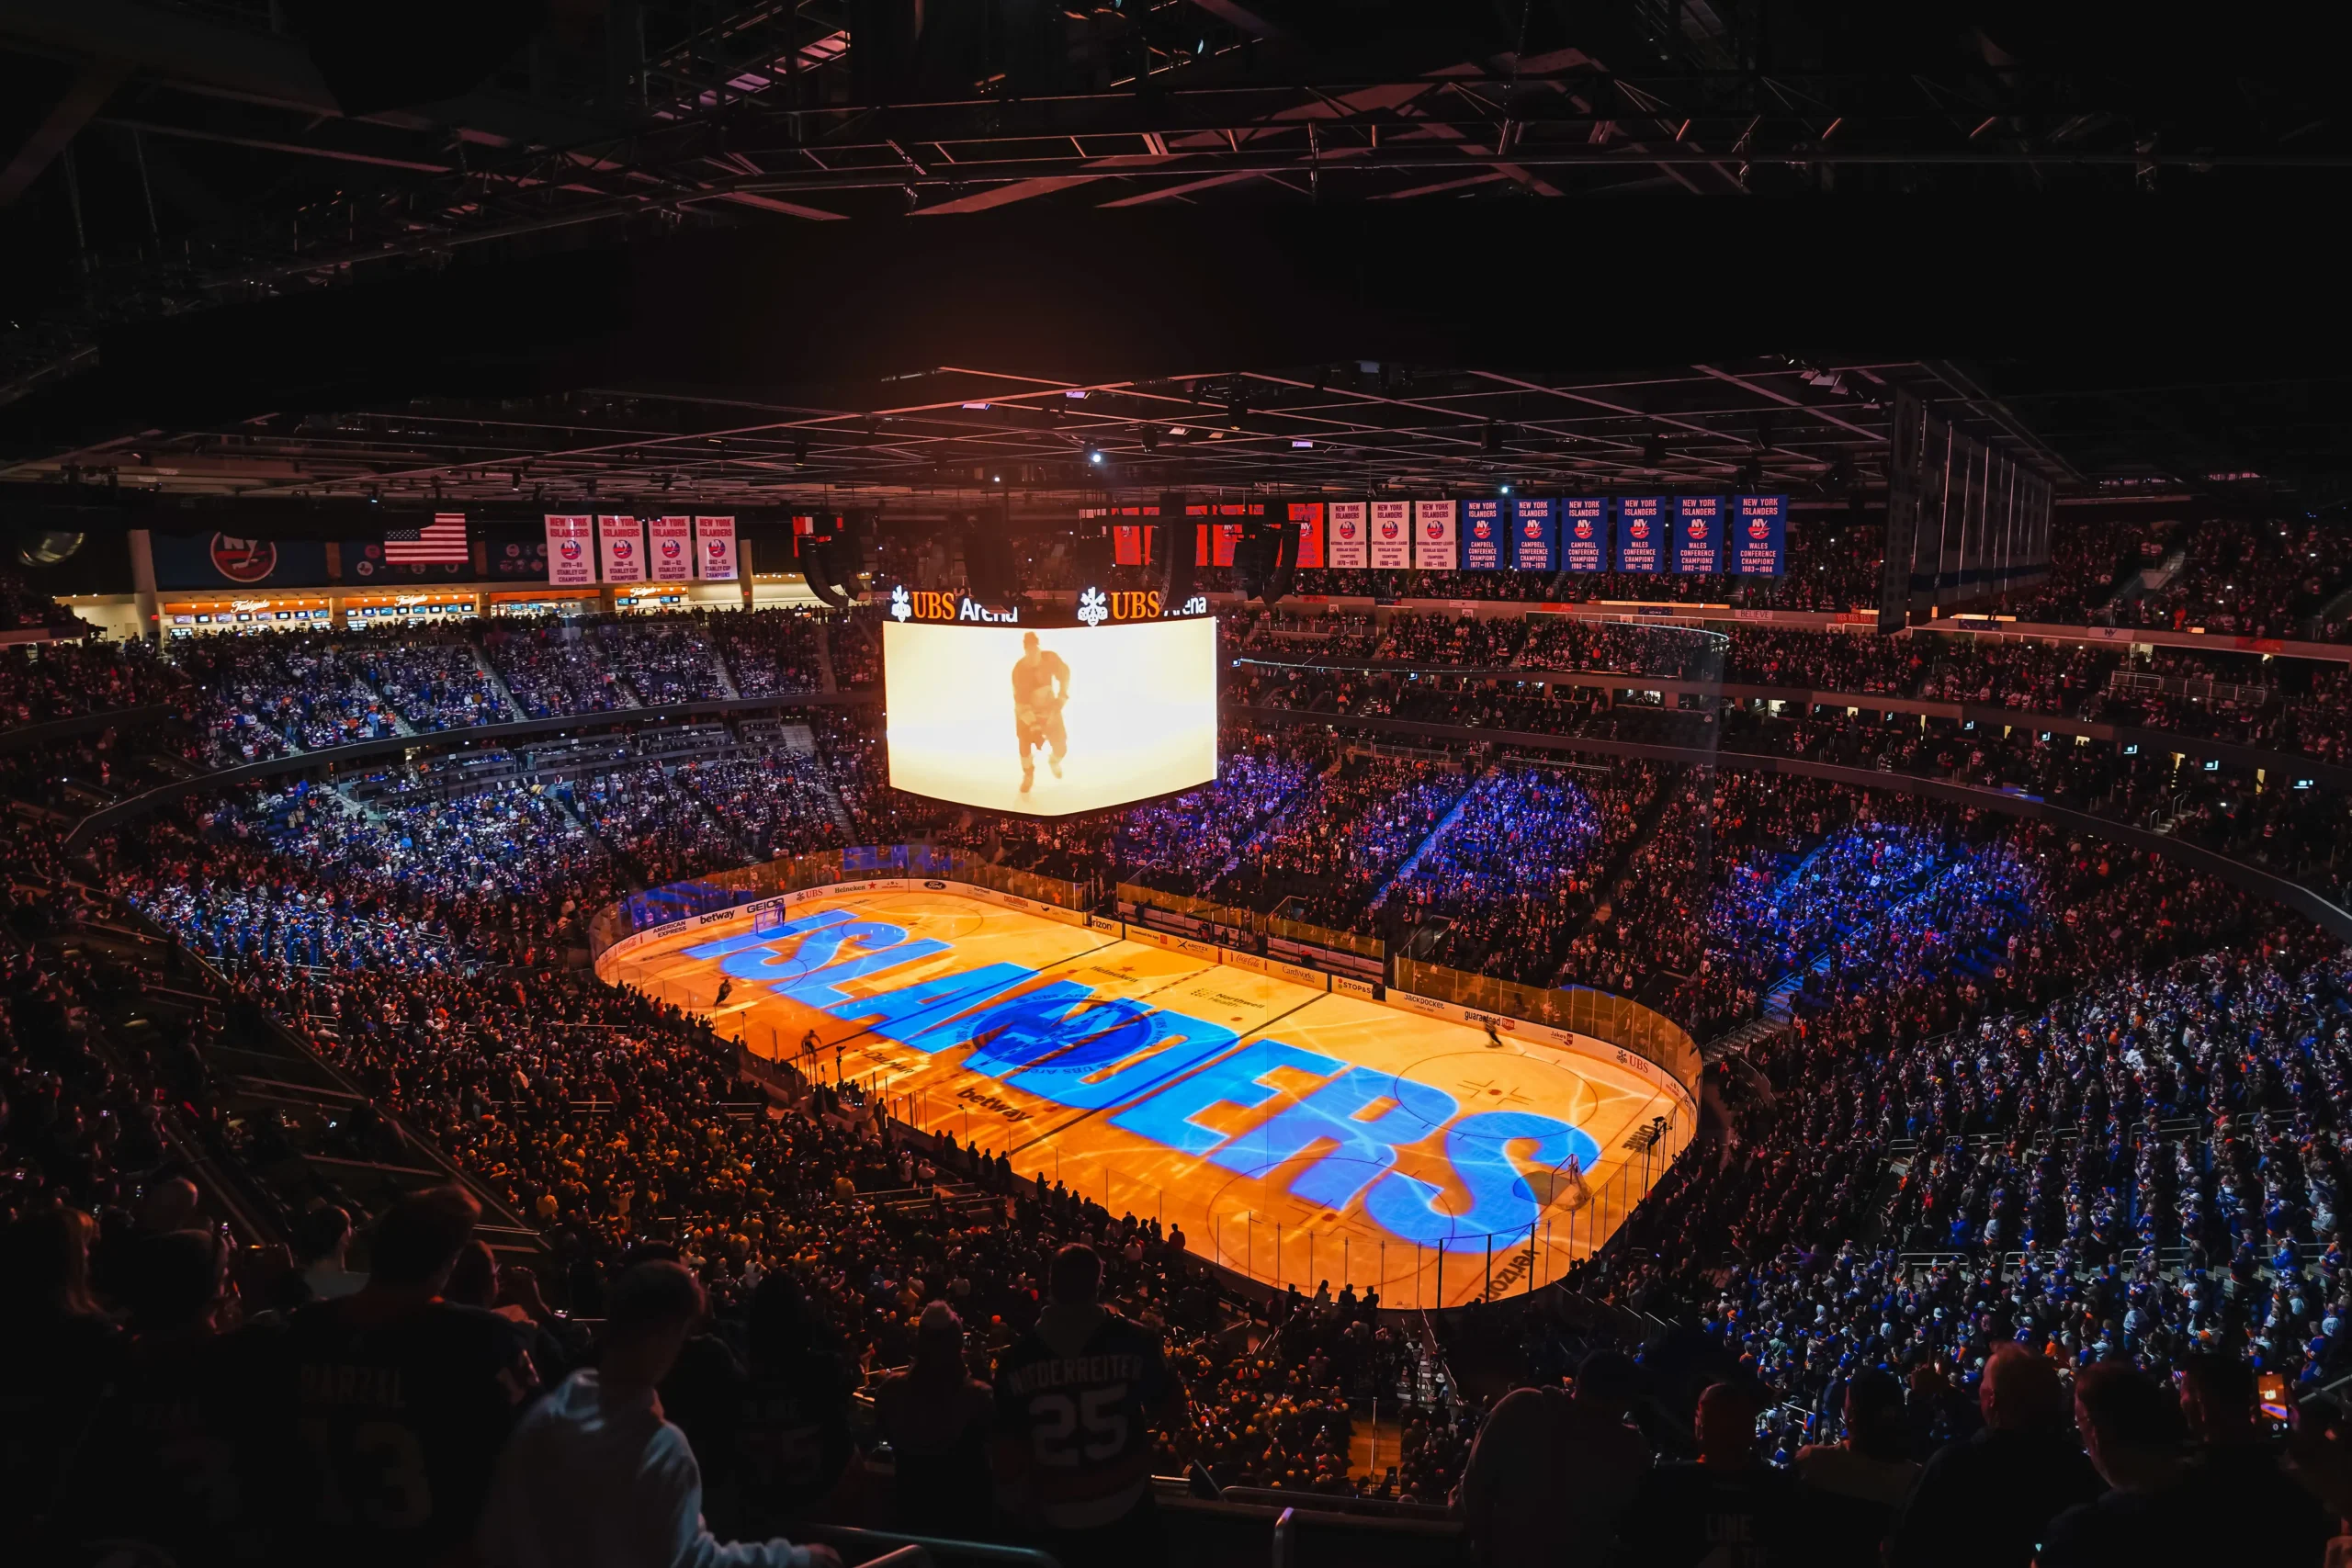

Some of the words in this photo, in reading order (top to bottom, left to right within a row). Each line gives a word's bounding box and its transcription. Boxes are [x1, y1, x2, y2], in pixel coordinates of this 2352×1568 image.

[1742, 507, 1778, 515] ISLANDERS
[549, 517, 566, 526] NEW
[670, 518, 686, 526] YORK
[699, 518, 713, 526] NEW
[716, 518, 731, 526] YORK
[550, 528, 589, 537] ISLANDERS
[603, 528, 640, 536] ISLANDERS
[652, 528, 687, 536] ISLANDERS
[699, 528, 732, 536] ISLANDERS
[912, 591, 956, 620] UBS
[1110, 591, 1160, 620] UBS
[1162, 595, 1207, 616] ena
[1740, 610, 1770, 618] BELIEVE
[1860, 614, 1871, 622] YES
[806, 888, 823, 899] UBS
[834, 884, 865, 894] Heineken
[699, 909, 735, 925] betway
[652, 920, 686, 934] AMERICAN
[657, 926, 687, 938] EXPRESS
[1090, 965, 1139, 983] Heineken
[1282, 964, 1316, 980] CardWorks
[1343, 981, 1373, 994] STOP&S
[1216, 993, 1265, 1009] Northwell
[1629, 1055, 1649, 1074] UBS
[681, 908, 1602, 1252] ISLANDERS
[956, 1087, 1035, 1122] betway
[1008, 1353, 1145, 1398] NIEDERREITER
[1027, 1382, 1128, 1467] 25
